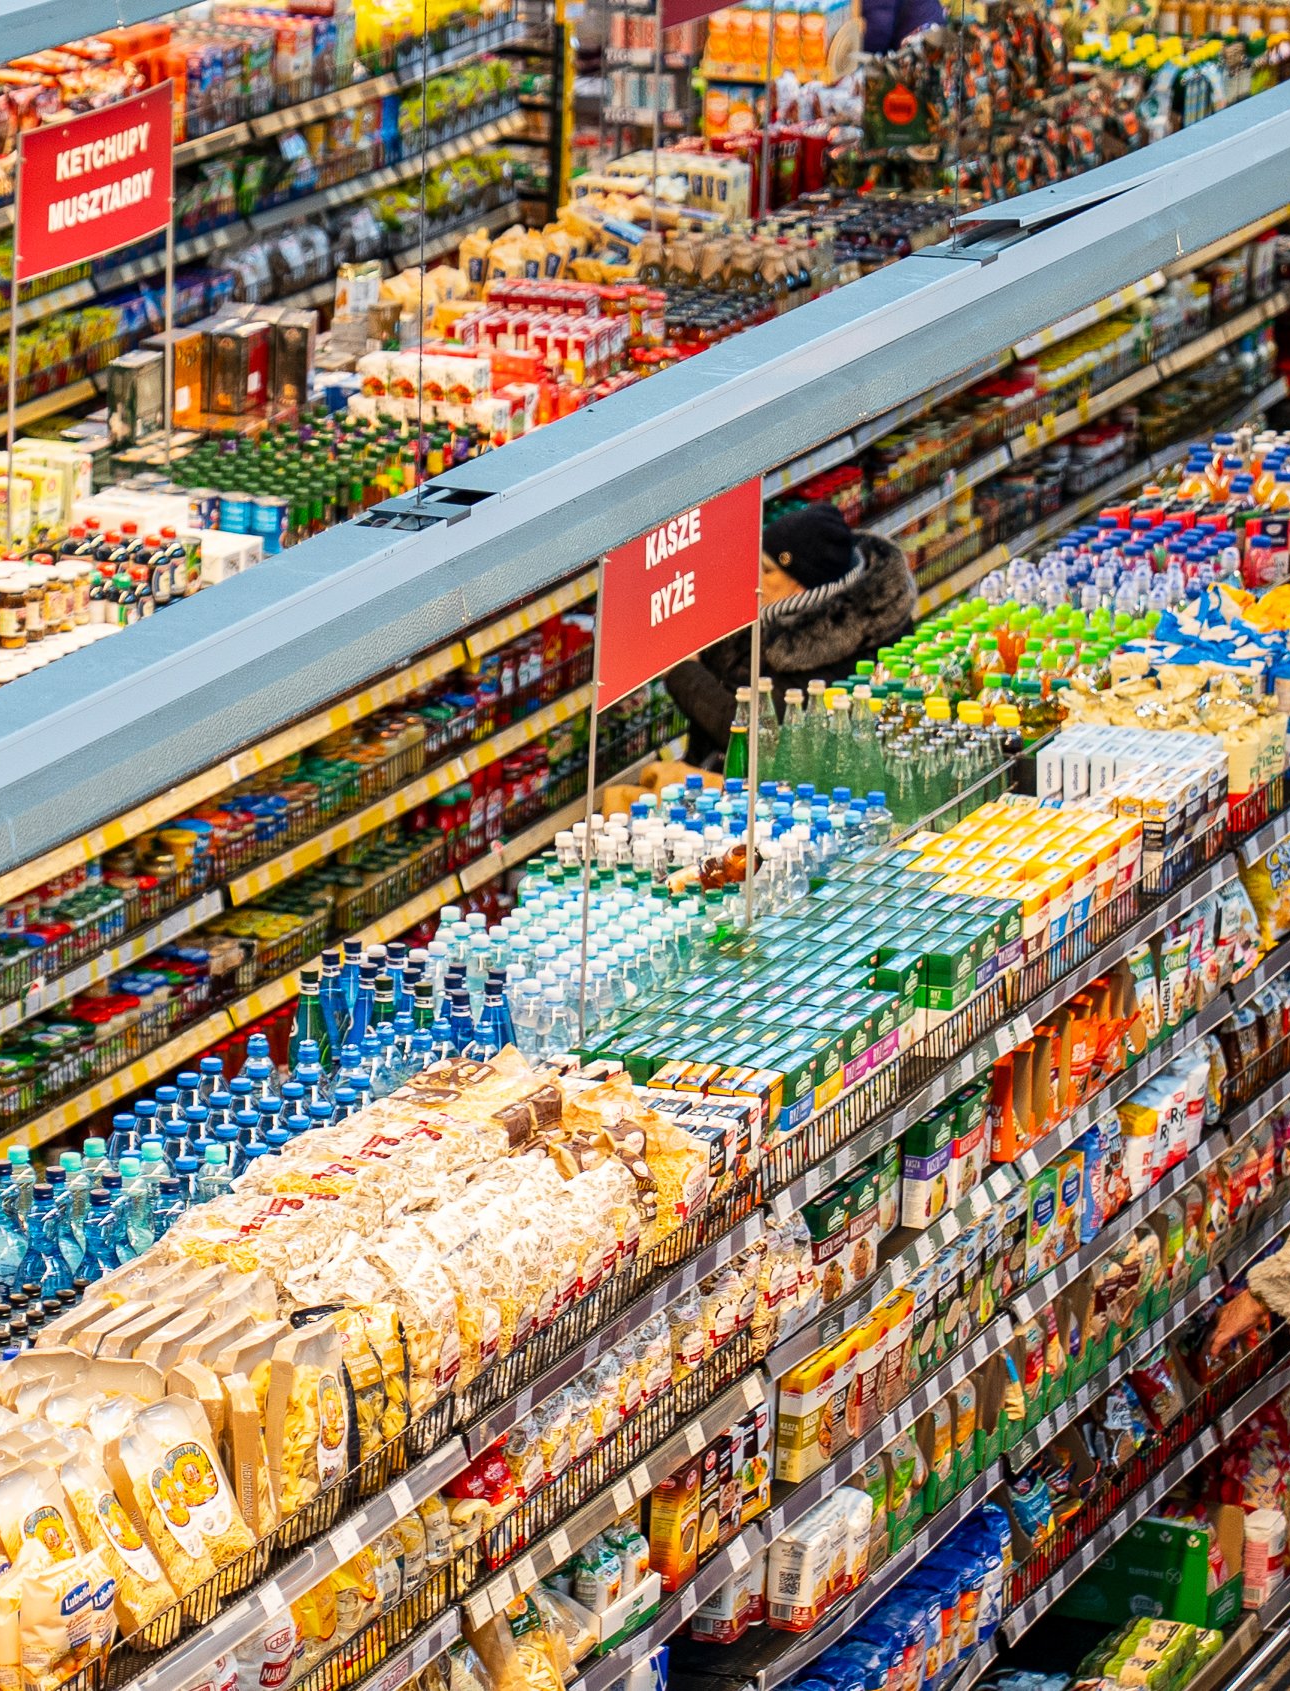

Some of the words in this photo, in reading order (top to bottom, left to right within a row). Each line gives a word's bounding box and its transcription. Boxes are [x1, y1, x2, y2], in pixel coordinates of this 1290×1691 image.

[56, 121, 151, 182] KETCHUPY
[48, 168, 154, 233] MUSZTARDY
[646, 508, 701, 570] KASZE
[650, 571, 695, 627] RYŻE
